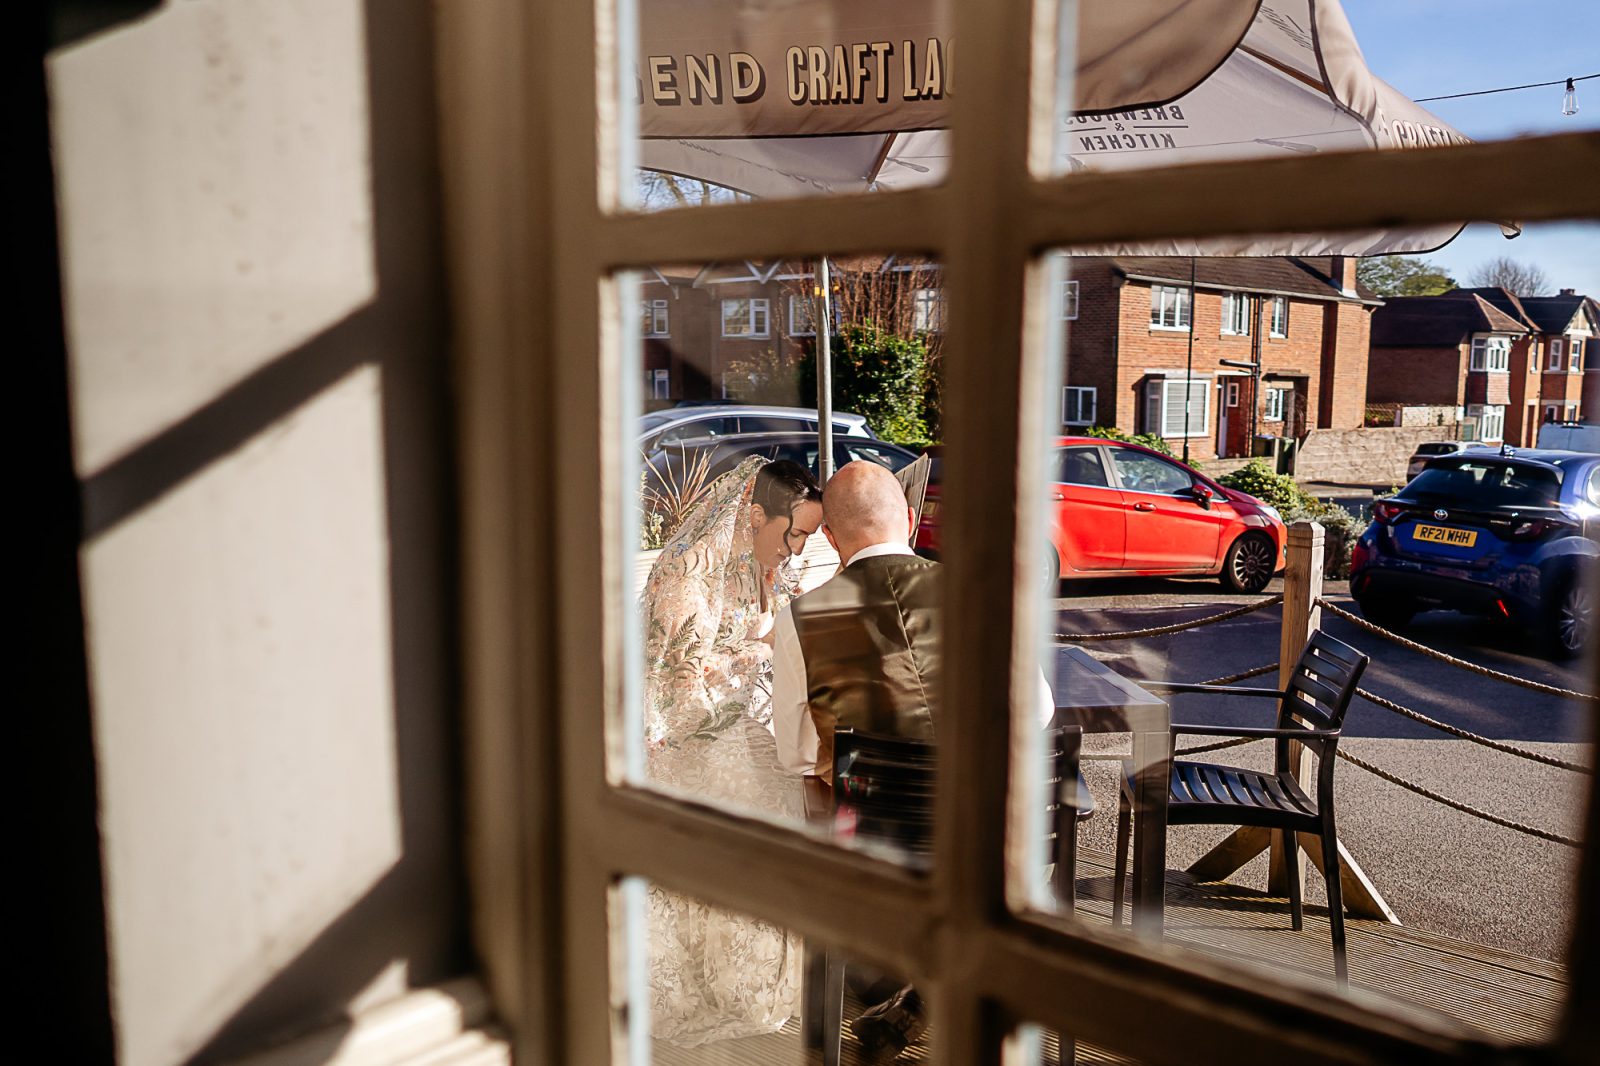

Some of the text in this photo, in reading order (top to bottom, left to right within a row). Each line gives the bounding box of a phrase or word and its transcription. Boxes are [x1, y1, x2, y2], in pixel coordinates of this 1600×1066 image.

[786, 42, 894, 106] CRAFT
[1420, 526, 1470, 544] RF21 WHH
